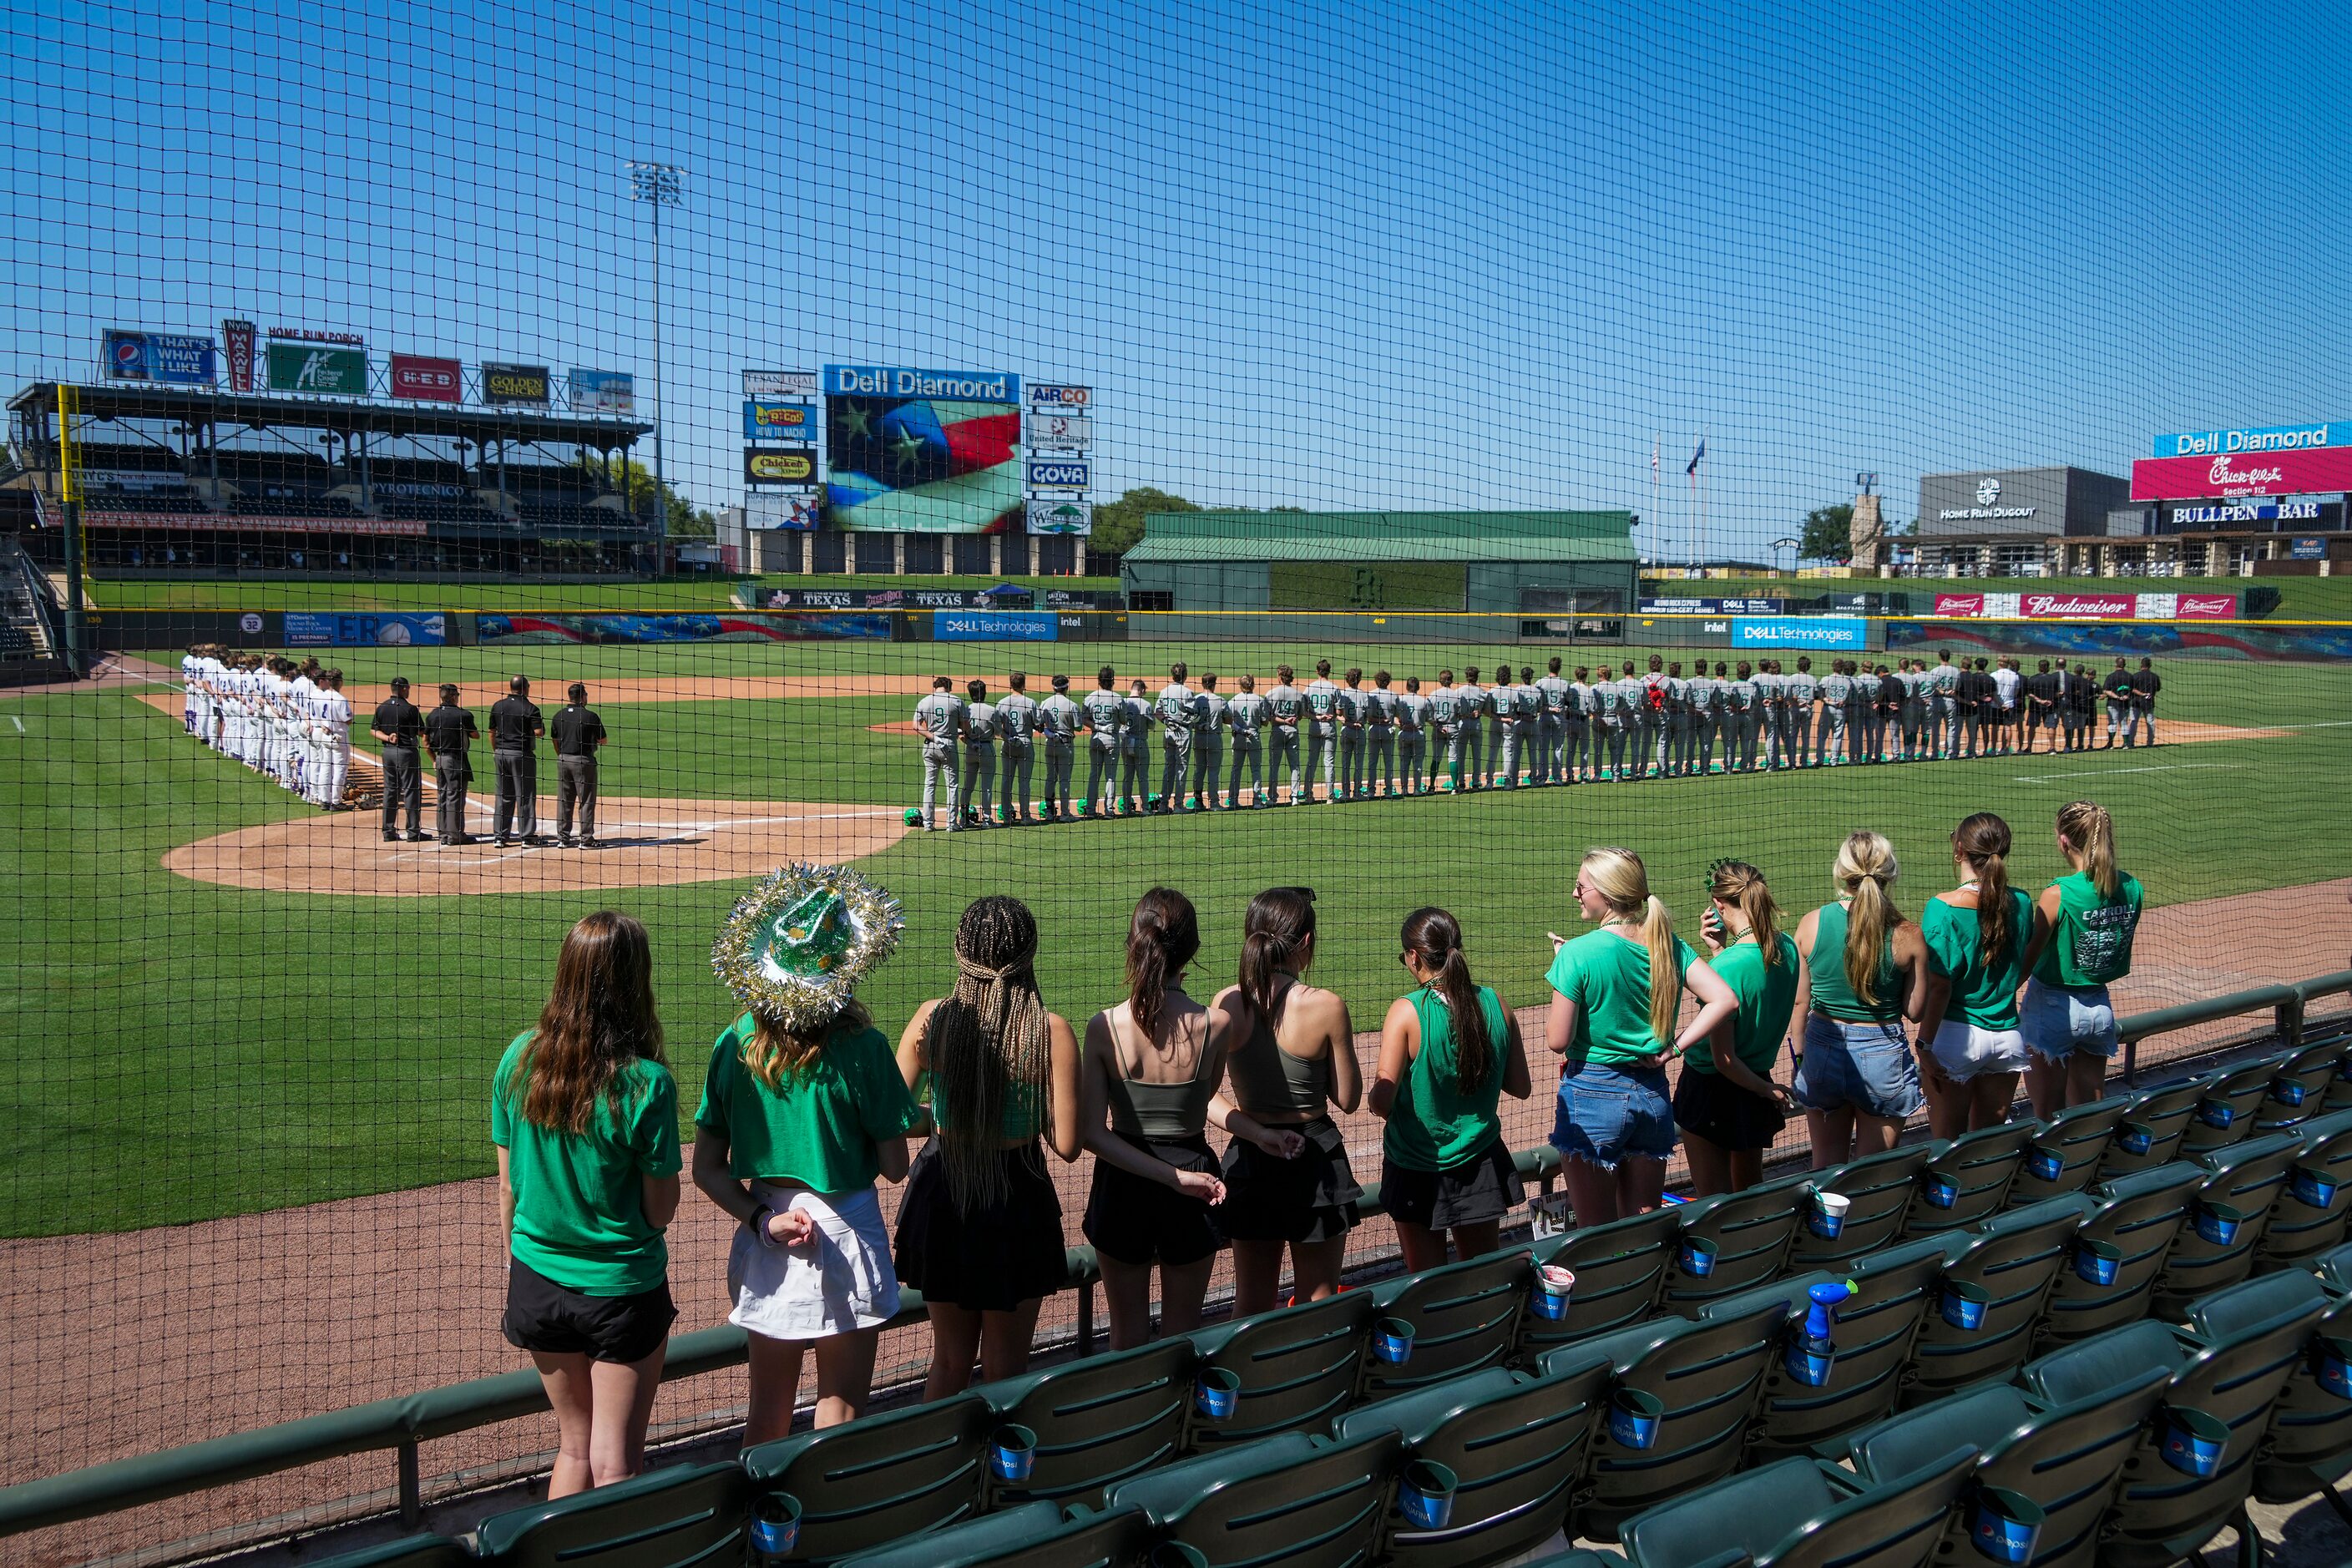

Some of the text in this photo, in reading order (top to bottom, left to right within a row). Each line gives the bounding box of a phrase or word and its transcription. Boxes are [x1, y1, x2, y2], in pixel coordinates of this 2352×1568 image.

[227, 321, 250, 331] Nyle
[268, 326, 363, 343] HOME RUN PORCH
[156, 336, 208, 349] THAT'S
[157, 348, 201, 362] WHAT
[231, 333, 248, 391] MAXWELL
[159, 361, 201, 374] I LIKE
[317, 368, 343, 377] Federal
[491, 376, 544, 388] GOLDEN
[839, 367, 1006, 399] Dell Diamond
[756, 427, 806, 438] HOW TO NACHO
[2177, 424, 2328, 455] Dell Diamond
[1029, 434, 1089, 446] United Heritage
[760, 458, 803, 468] Chicken
[1033, 466, 1085, 483] GOYA
[2209, 456, 2282, 485] Chick-fil-A
[371, 483, 464, 498] PYROTECNICO
[2223, 486, 2266, 496] Section 112
[1940, 506, 2036, 519] HOME RUN DUGOUT
[2172, 503, 2319, 524] BULLPEN BAR
[803, 595, 851, 604] TEXAS
[918, 596, 962, 605] TEXAS
[1722, 599, 1745, 609] DELL
[2027, 596, 2127, 615] Budweiser
[2185, 600, 2224, 610] Budweiser
[245, 620, 258, 630] 32
[947, 620, 1046, 635] DELL Technologies
[1060, 616, 1080, 626] intel
[1704, 622, 1727, 632] intel
[1744, 626, 1853, 643] DELL Technologies
[1939, 675, 1954, 686] 44
[1545, 690, 1558, 704] 15
[1692, 690, 1708, 703] 23
[1829, 685, 1846, 698] 33
[1310, 694, 1329, 709] 00
[1495, 698, 1508, 712] 12
[1601, 694, 1614, 707] 18
[934, 707, 944, 724] 9
[1050, 707, 1059, 724] 3
[1094, 705, 1113, 721] 25
[1241, 706, 1248, 721] 4
[1407, 706, 1415, 720] 7
[1435, 701, 1450, 716] 10
[1009, 711, 1019, 726] 8
[2081, 904, 2136, 920] CARROLL
[2092, 913, 2132, 927] BASEBALL
[1819, 1221, 1838, 1230] pepsi
[1691, 1259, 1710, 1268] pepsi
[2081, 1262, 2109, 1278] AQUAFINA
[1539, 1300, 1559, 1311] pepsi
[1946, 1306, 1975, 1323] AQUAFINA
[1383, 1343, 1404, 1354] pepsi
[1790, 1362, 1818, 1378] AQUAFINA
[1205, 1396, 1227, 1409] pepsi
[1614, 1422, 1644, 1442] AQUAFINA
[995, 1456, 1017, 1469] pepsi
[2185, 1450, 2215, 1464] pepsi
[1403, 1501, 1431, 1523] AQUAFINA
[753, 1527, 774, 1542] pepsi
[1995, 1535, 2029, 1550] pepsi
